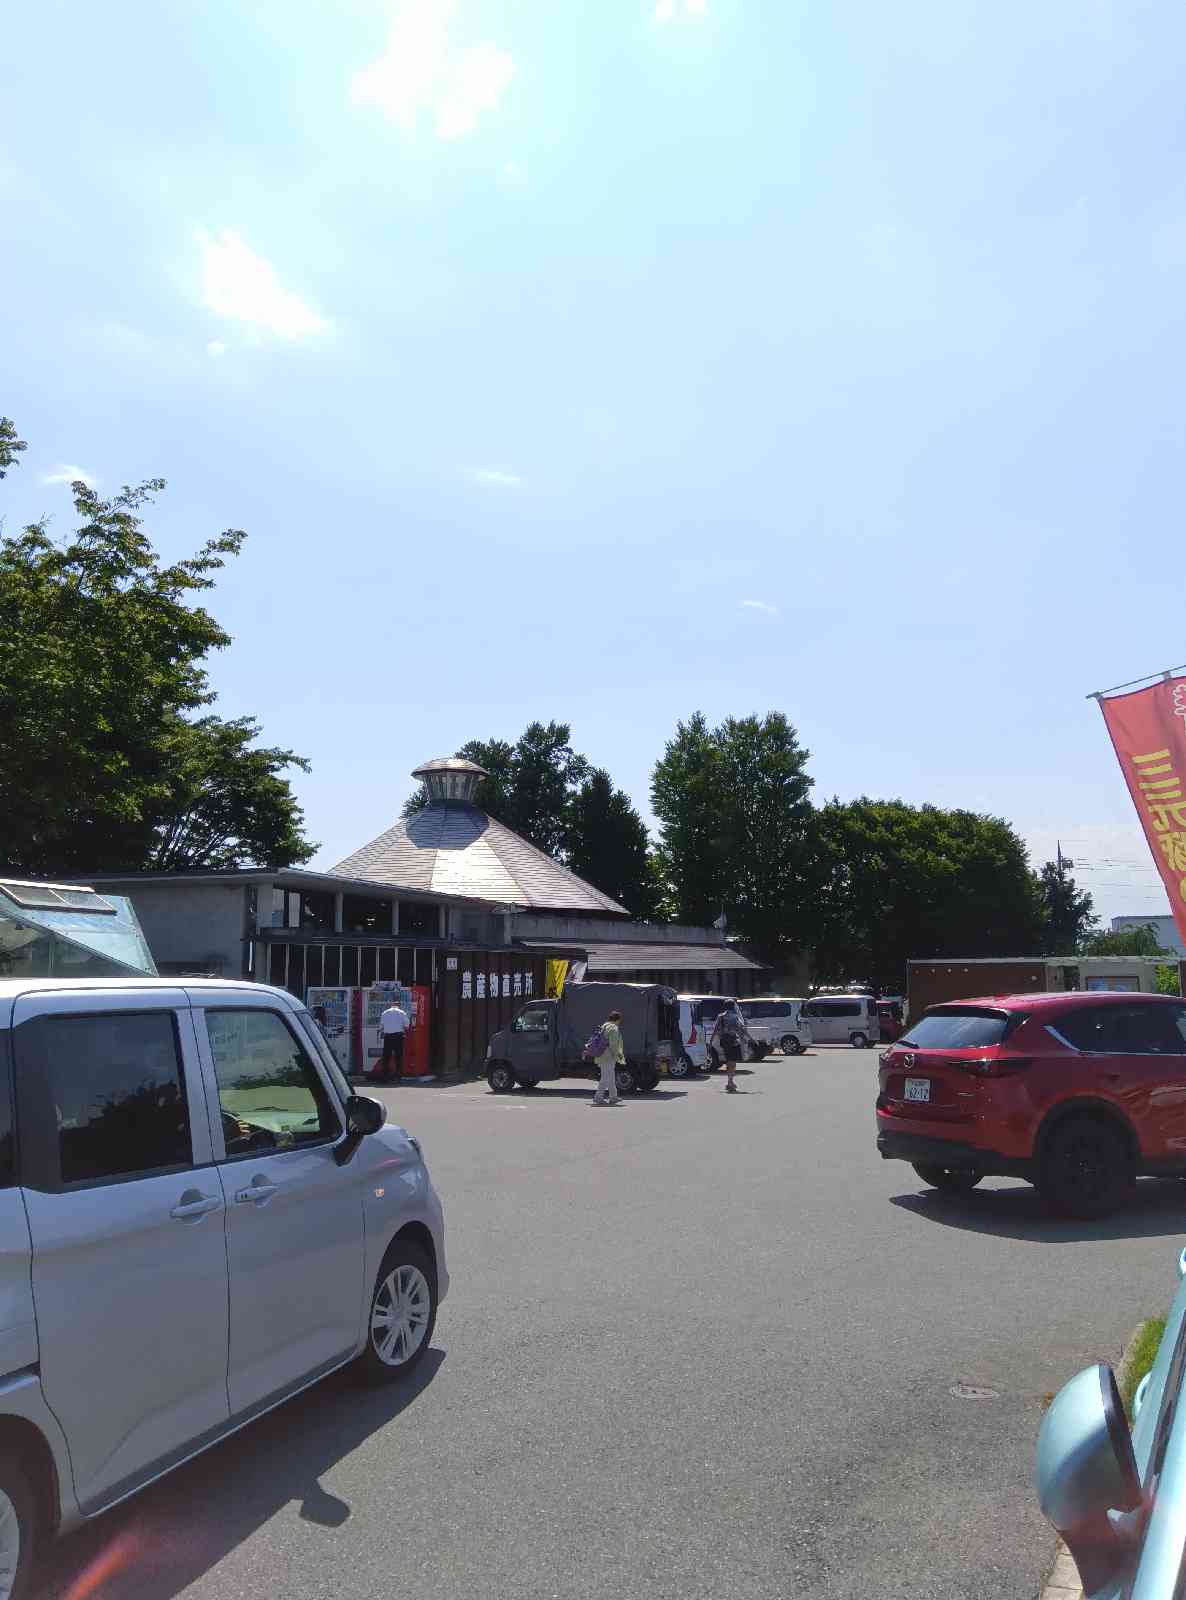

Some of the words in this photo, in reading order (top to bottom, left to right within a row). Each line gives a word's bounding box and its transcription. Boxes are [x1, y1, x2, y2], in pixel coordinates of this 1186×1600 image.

[462, 970, 533, 999] 農産物直売所
